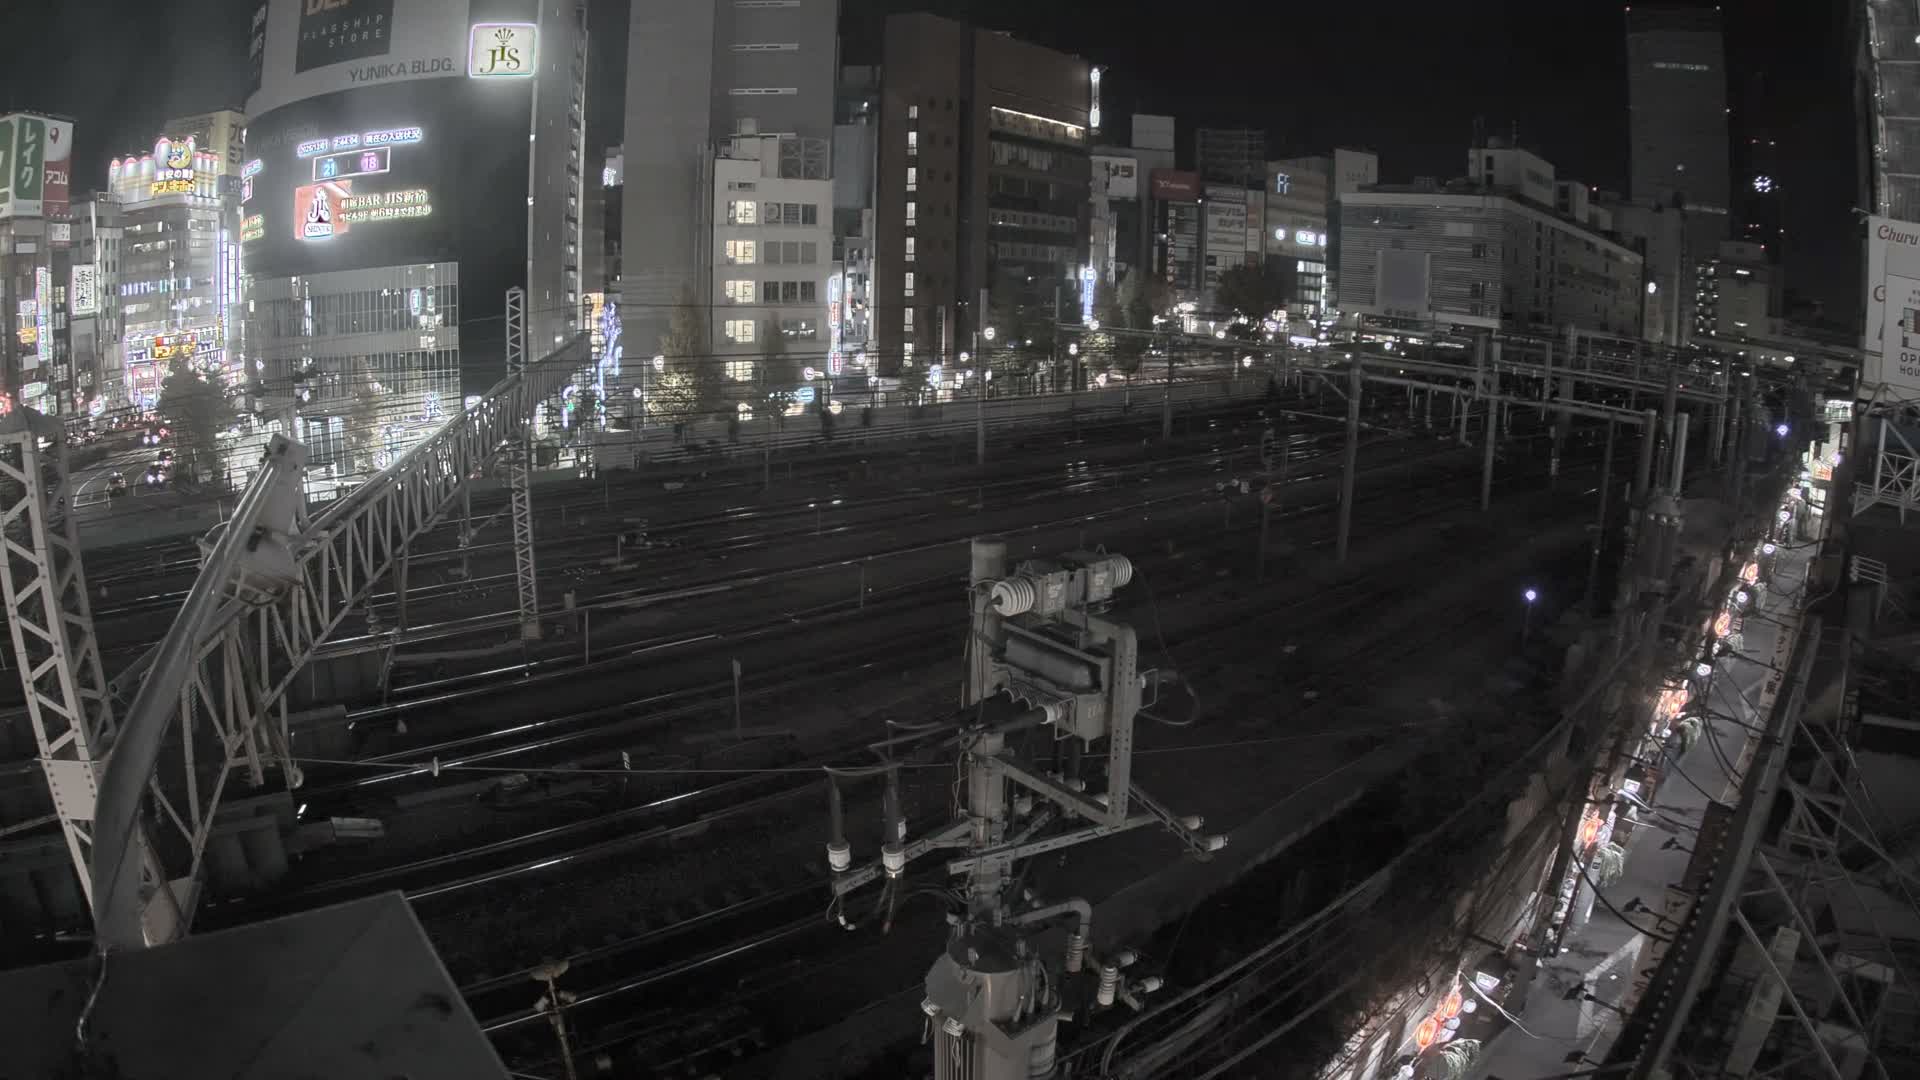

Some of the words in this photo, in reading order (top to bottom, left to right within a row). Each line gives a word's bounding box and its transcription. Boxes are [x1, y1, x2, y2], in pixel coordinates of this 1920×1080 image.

[303, 14, 383, 41] FLAGSHIP
[328, 29, 383, 48] STORE
[349, 62, 408, 82] YUNIKA
[411, 57, 456, 75] BLDG.
[479, 45, 521, 74] JIS
[21, 121, 37, 189] レイク
[364, 156, 377, 170] 18
[45, 169, 69, 185] アコム
[323, 163, 336, 176] 21
[1878, 224, 1919, 246] Churu
[1899, 352, 1920, 366] OP
